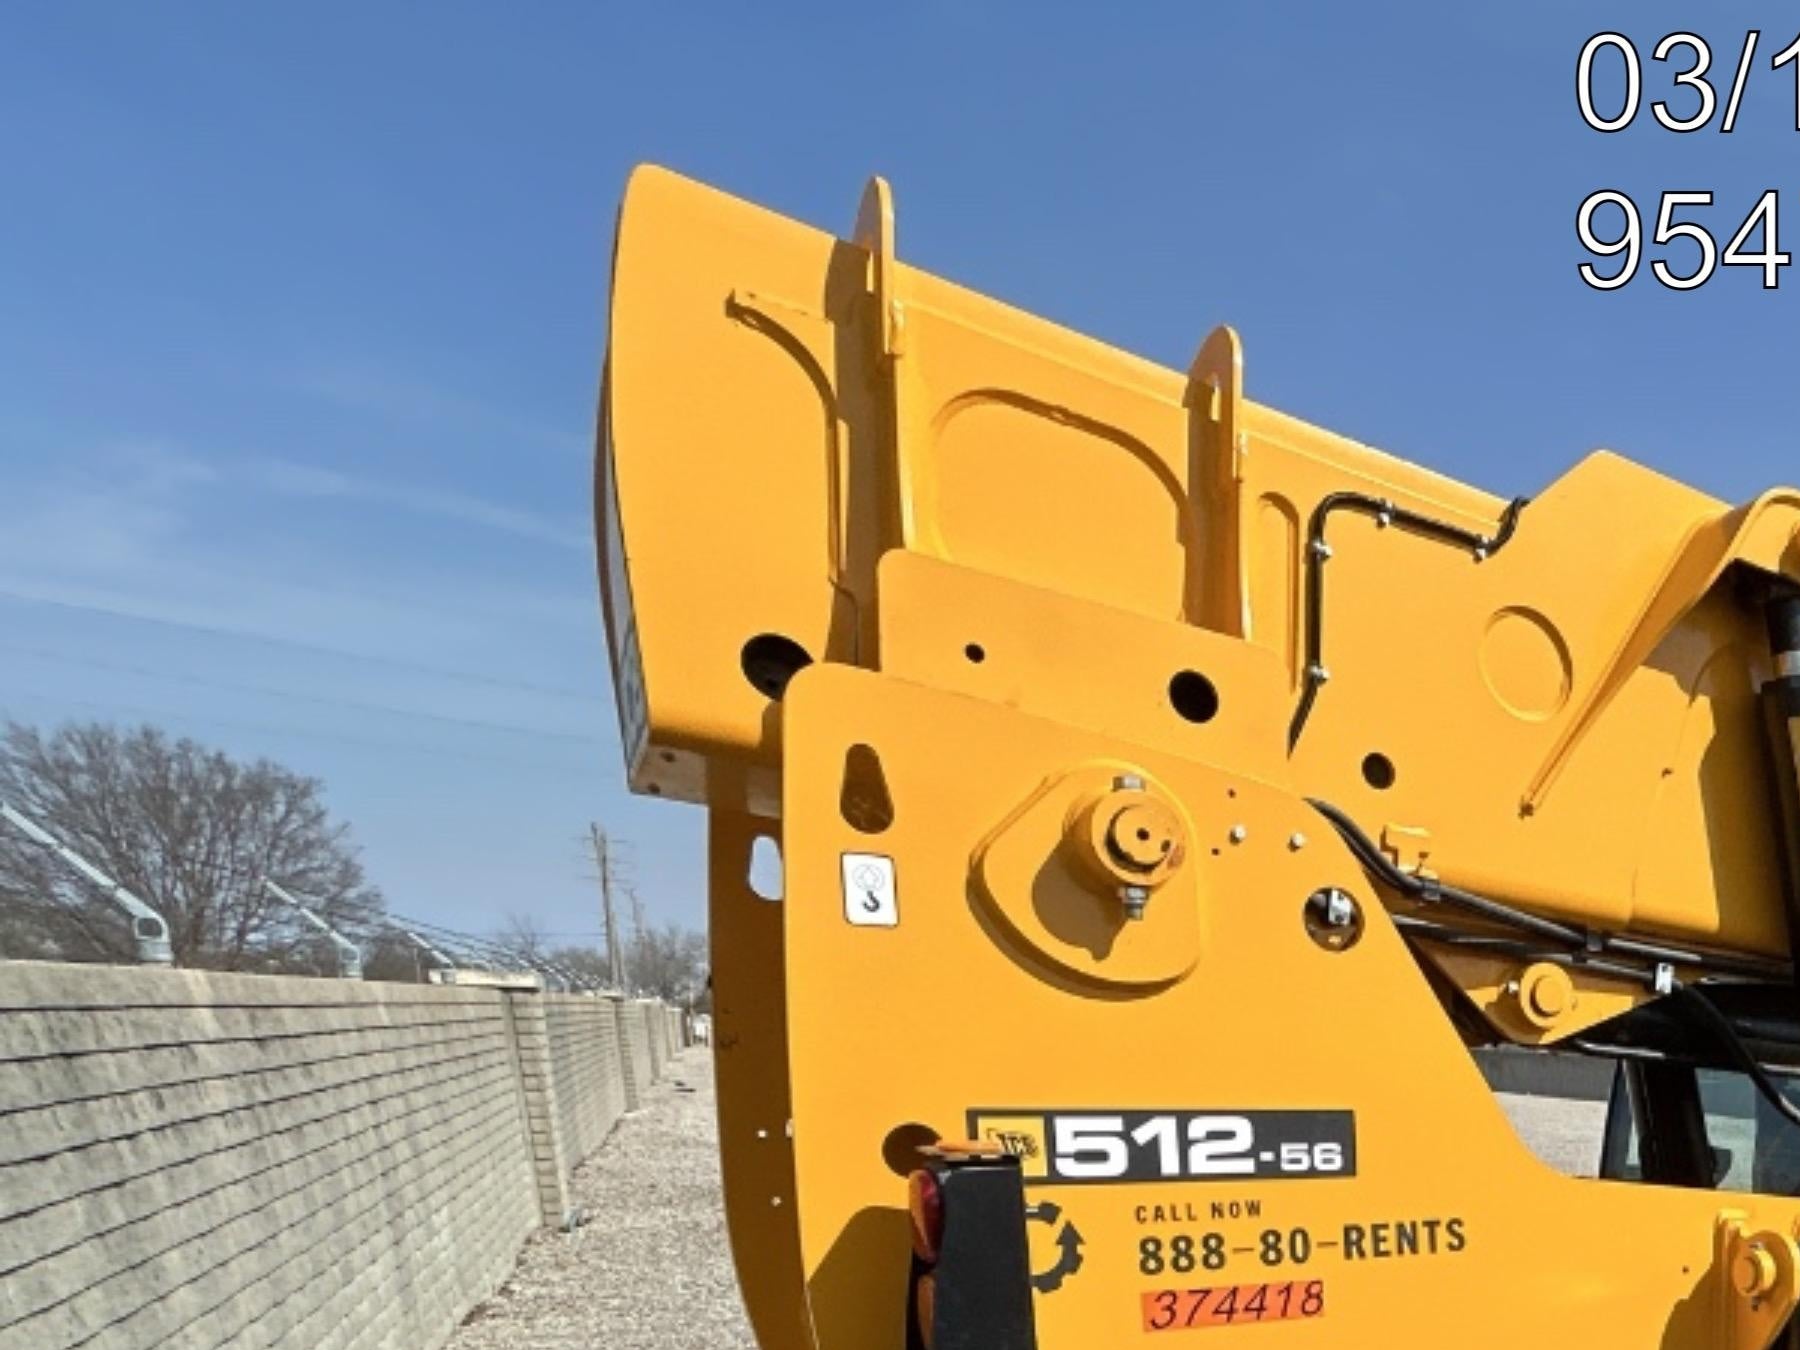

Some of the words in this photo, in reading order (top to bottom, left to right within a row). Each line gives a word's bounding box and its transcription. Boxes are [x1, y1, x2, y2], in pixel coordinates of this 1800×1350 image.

[1053, 1115, 1344, 1178] 512-56
[1135, 1204, 1198, 1225] CALL
[1211, 1200, 1263, 1220] NOW
[1138, 1218, 1467, 1277] 888-80-RENTS
[1149, 1280, 1325, 1331] 374418
